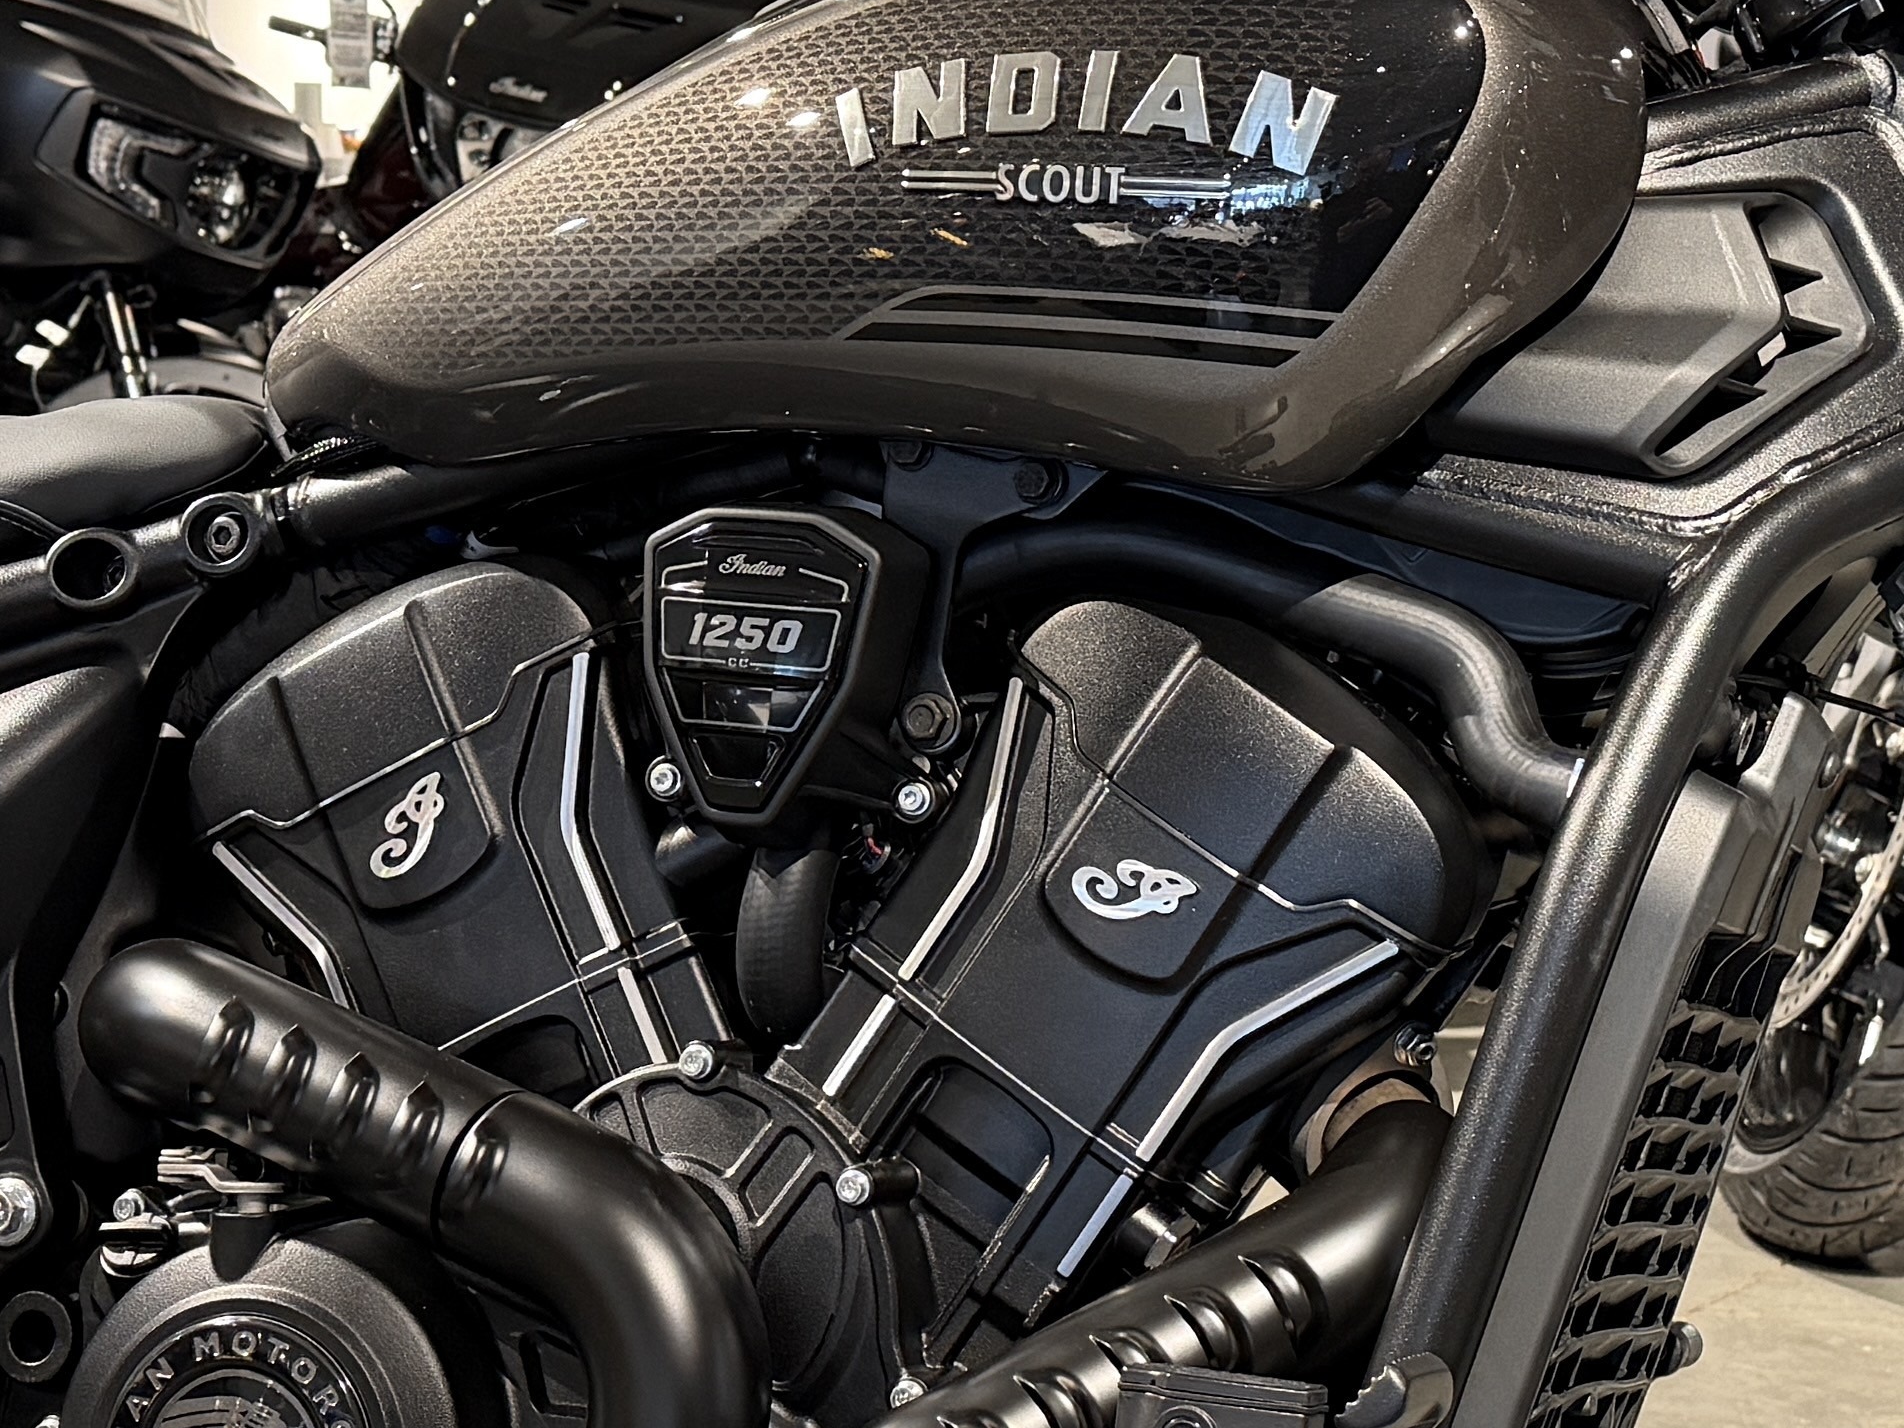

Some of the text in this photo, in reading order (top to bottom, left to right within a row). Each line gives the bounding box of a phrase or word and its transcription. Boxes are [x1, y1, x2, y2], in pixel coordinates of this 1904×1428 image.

[834, 48, 1337, 179] INDIAN
[994, 163, 1127, 206] SCOUT
[718, 553, 787, 577] Indian
[688, 612, 803, 654] 1250
